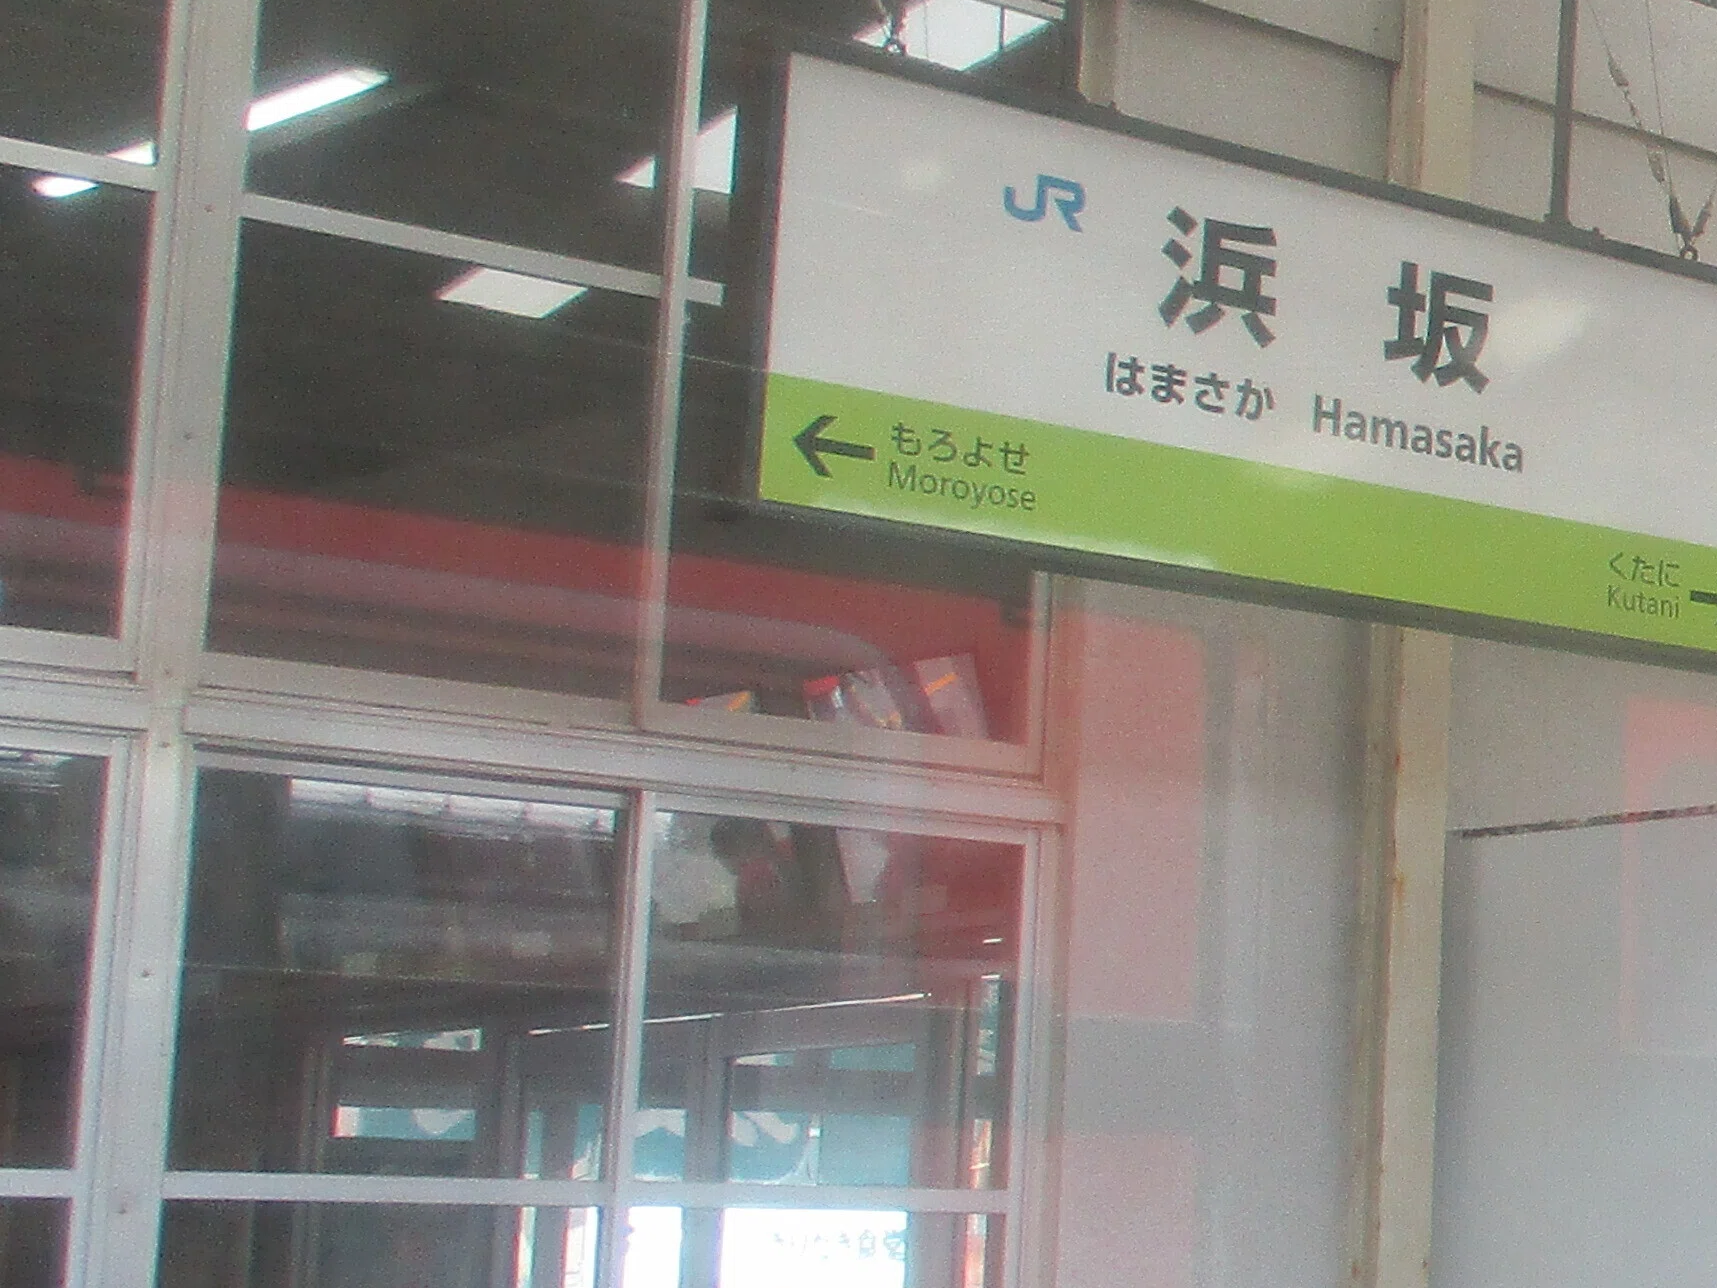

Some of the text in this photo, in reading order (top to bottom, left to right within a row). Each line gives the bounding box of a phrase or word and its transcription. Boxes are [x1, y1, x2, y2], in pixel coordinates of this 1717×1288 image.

[1003, 173, 1087, 233] JR
[1159, 207, 1496, 395] 浜坂
[1104, 351, 1275, 422] はまさか
[889, 422, 1031, 477] もろよせ
[1312, 395, 1525, 475] Hamasaka
[886, 464, 1038, 512] Moroyose
[1607, 551, 1681, 589] くたに
[1605, 586, 1681, 621] Kutani
